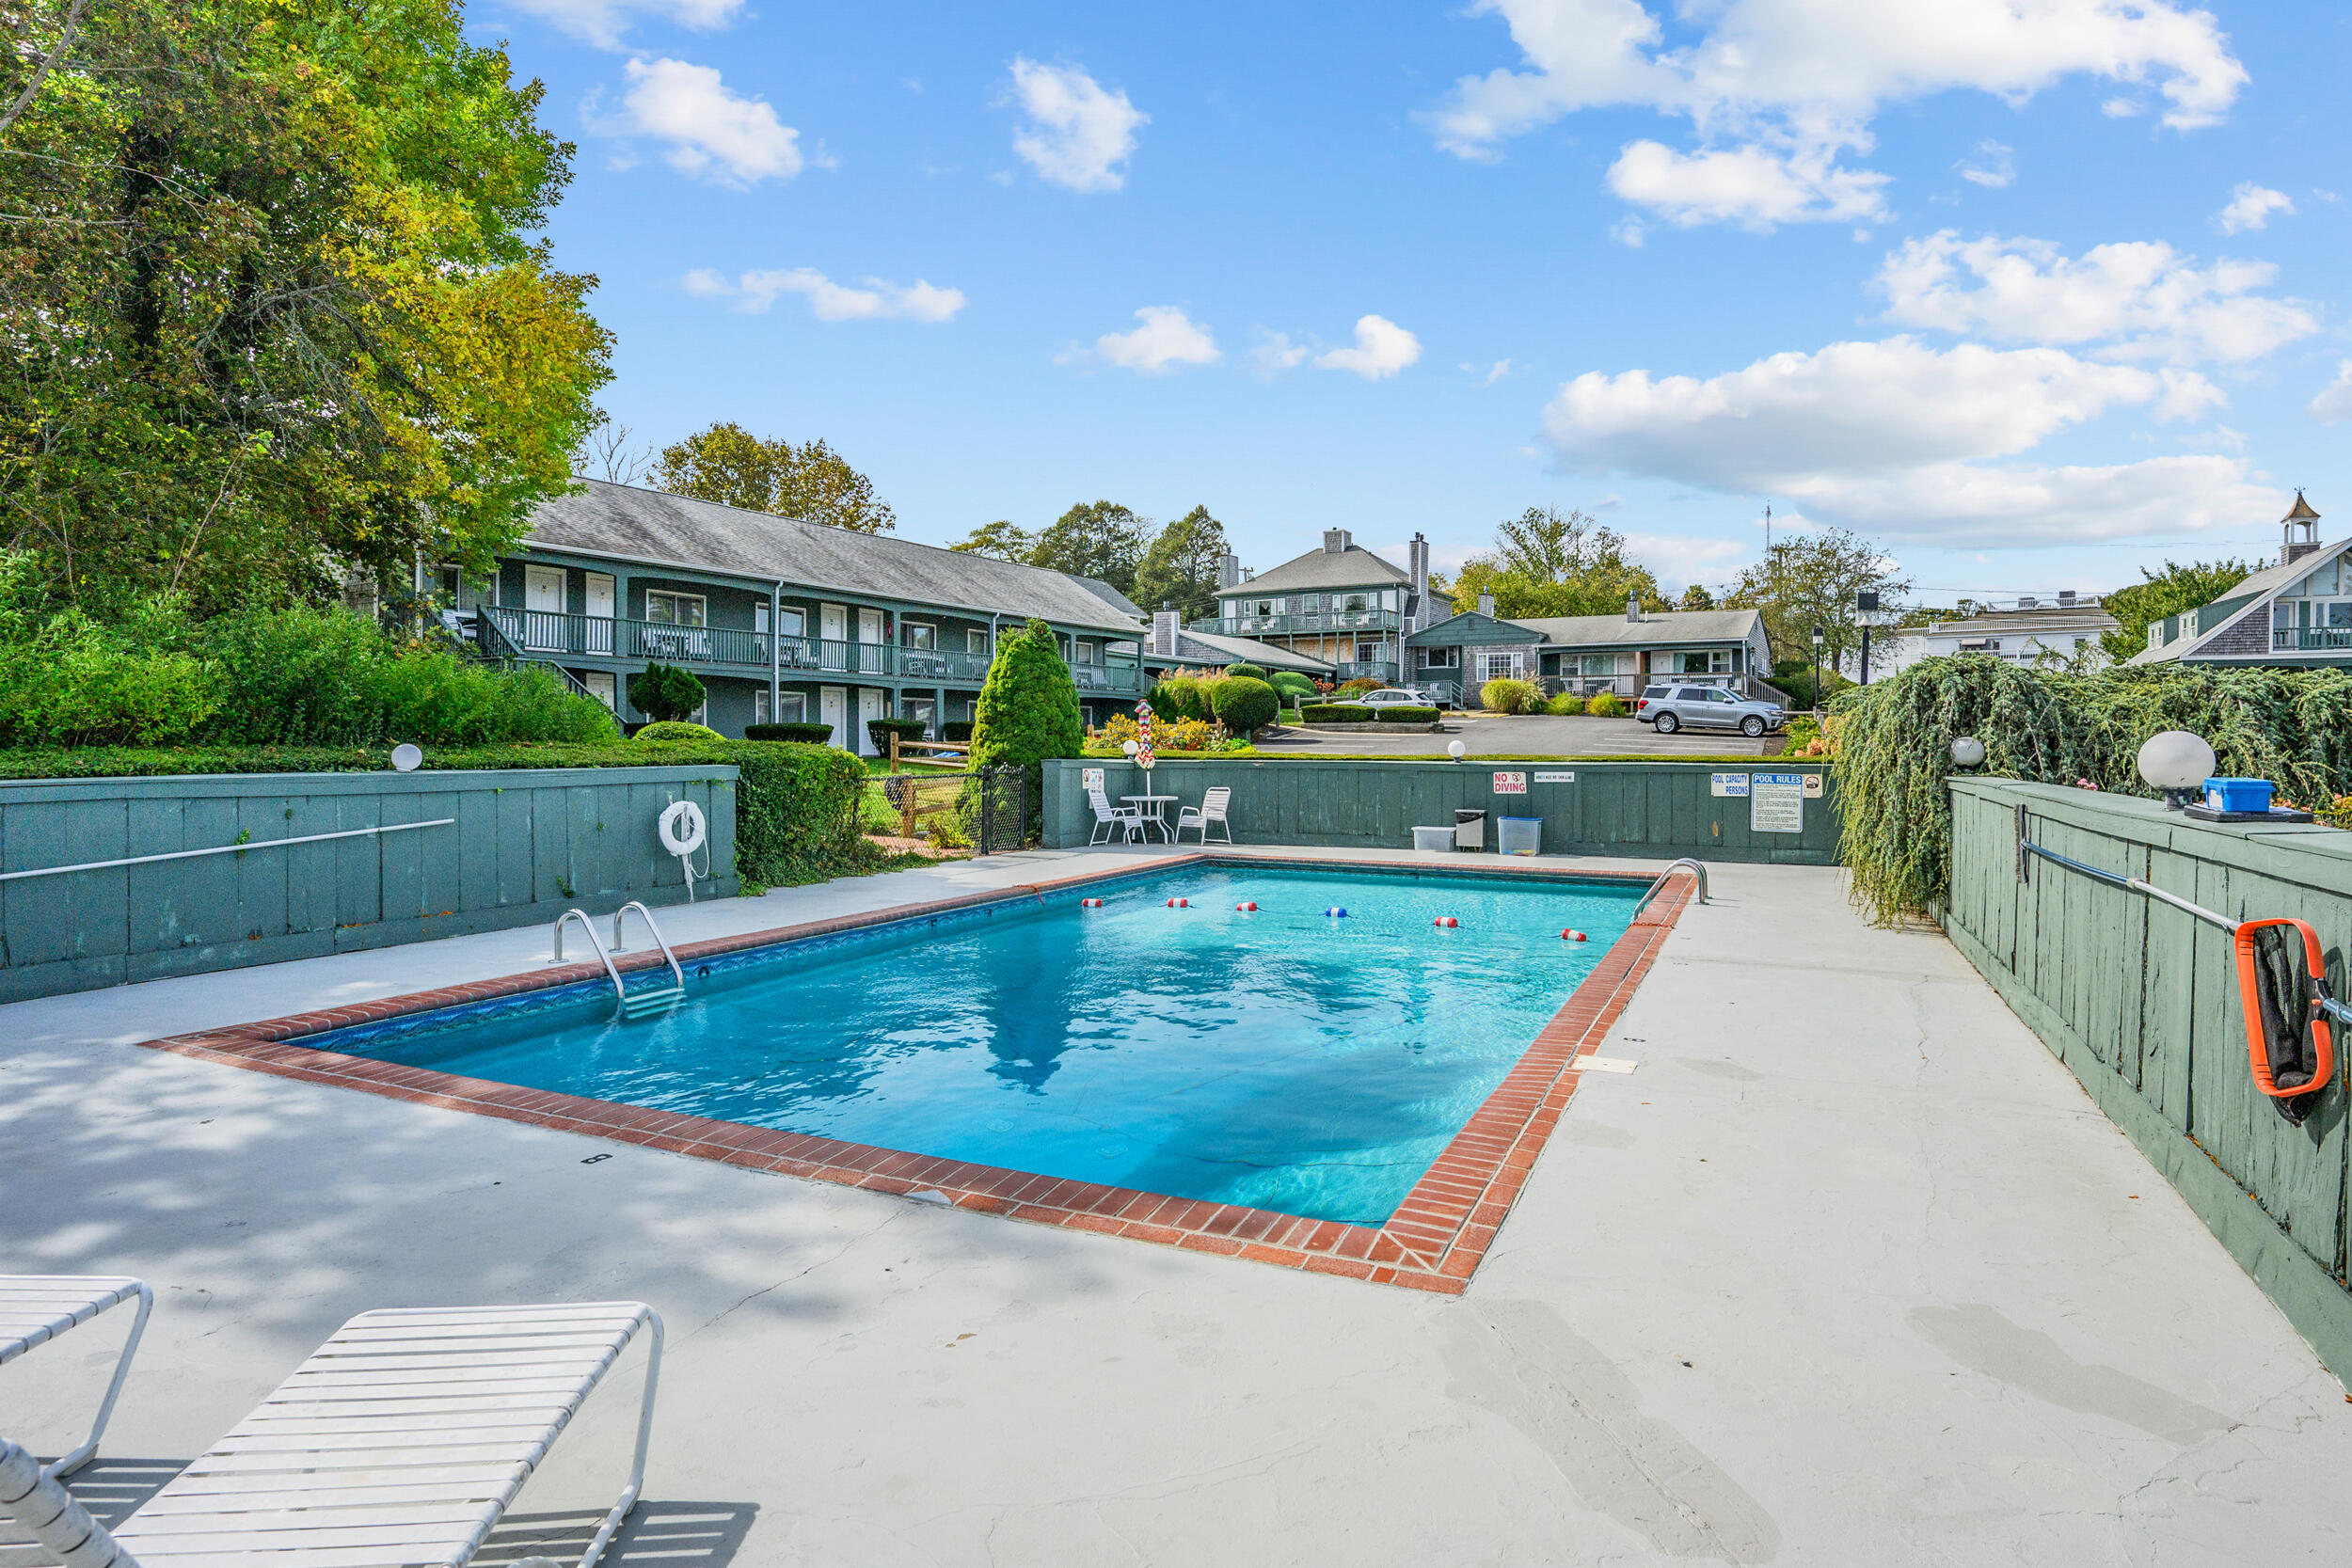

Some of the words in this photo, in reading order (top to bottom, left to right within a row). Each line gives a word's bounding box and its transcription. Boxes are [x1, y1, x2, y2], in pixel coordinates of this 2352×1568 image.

[1494, 773, 1507, 783] NO
[1712, 774, 1724, 784] POOL
[1725, 774, 1747, 784] CAPACITY
[1755, 775, 1773, 784] POOL
[1776, 775, 1801, 784] RULES
[1495, 783, 1525, 792] DIVING
[1725, 785, 1748, 795] PERSONS
